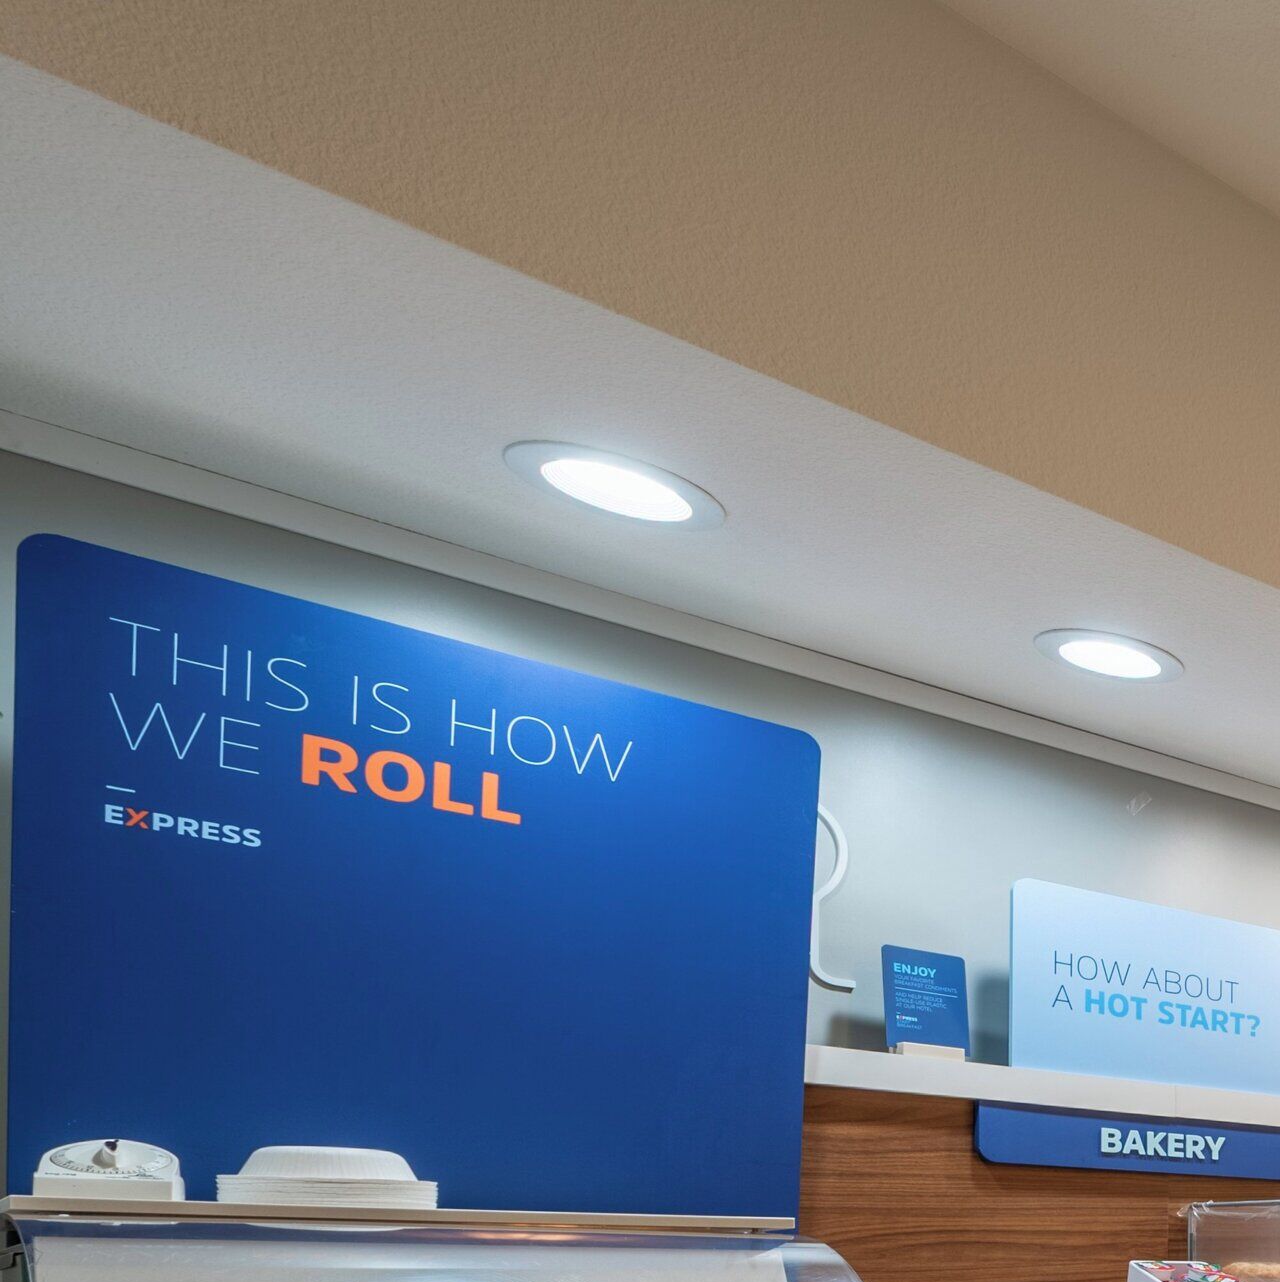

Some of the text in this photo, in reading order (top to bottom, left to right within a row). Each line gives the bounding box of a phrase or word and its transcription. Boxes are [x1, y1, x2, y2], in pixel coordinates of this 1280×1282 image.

[109, 616, 633, 782] THIS IS HOW
[109, 692, 522, 826] WE ROLL
[104, 803, 262, 848] EXPRESS
[893, 962, 937, 978] ENJOY
[1054, 950, 1239, 1004] HOW ABOUT
[1052, 984, 1261, 1037] A HOT START?
[1100, 1126, 1226, 1161] BAKERY
